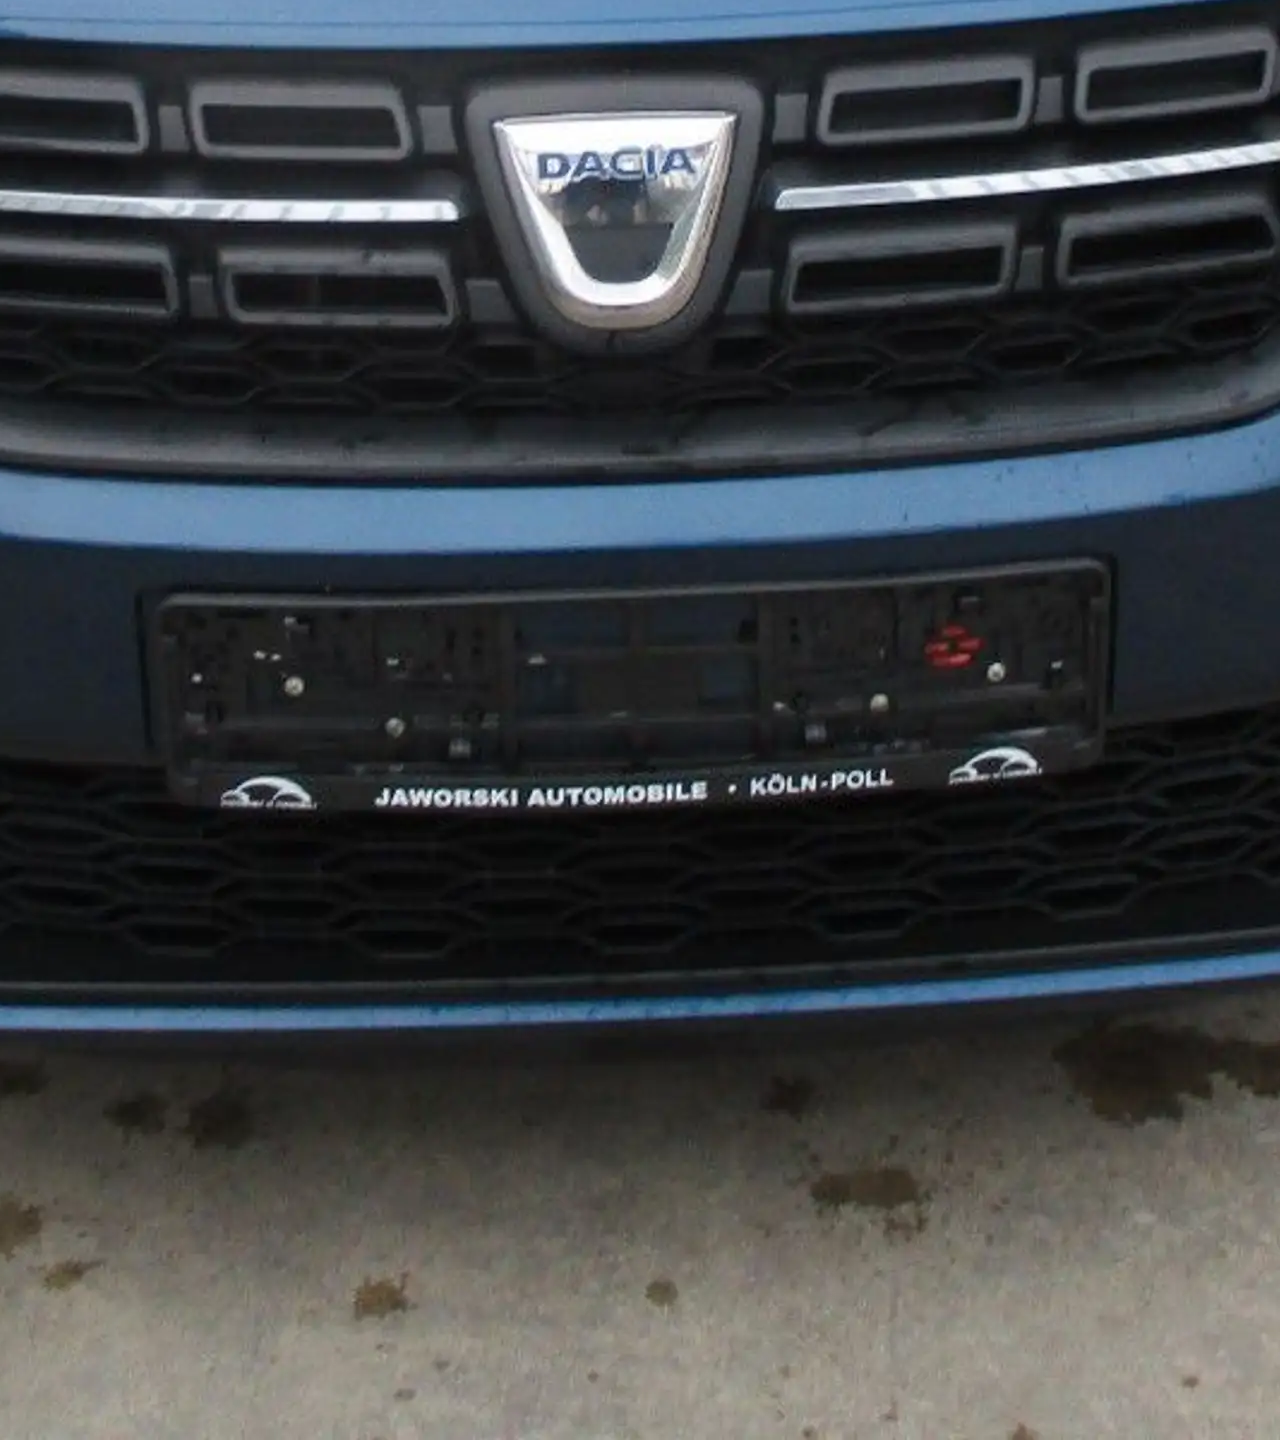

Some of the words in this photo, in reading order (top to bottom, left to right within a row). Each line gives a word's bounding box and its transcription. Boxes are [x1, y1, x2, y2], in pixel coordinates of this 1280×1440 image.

[537, 145, 696, 180] DACIA
[375, 787, 519, 809] JAWORSKI
[526, 781, 708, 808] AUTOMOBILE
[750, 768, 895, 797] KÖLN-POLL
